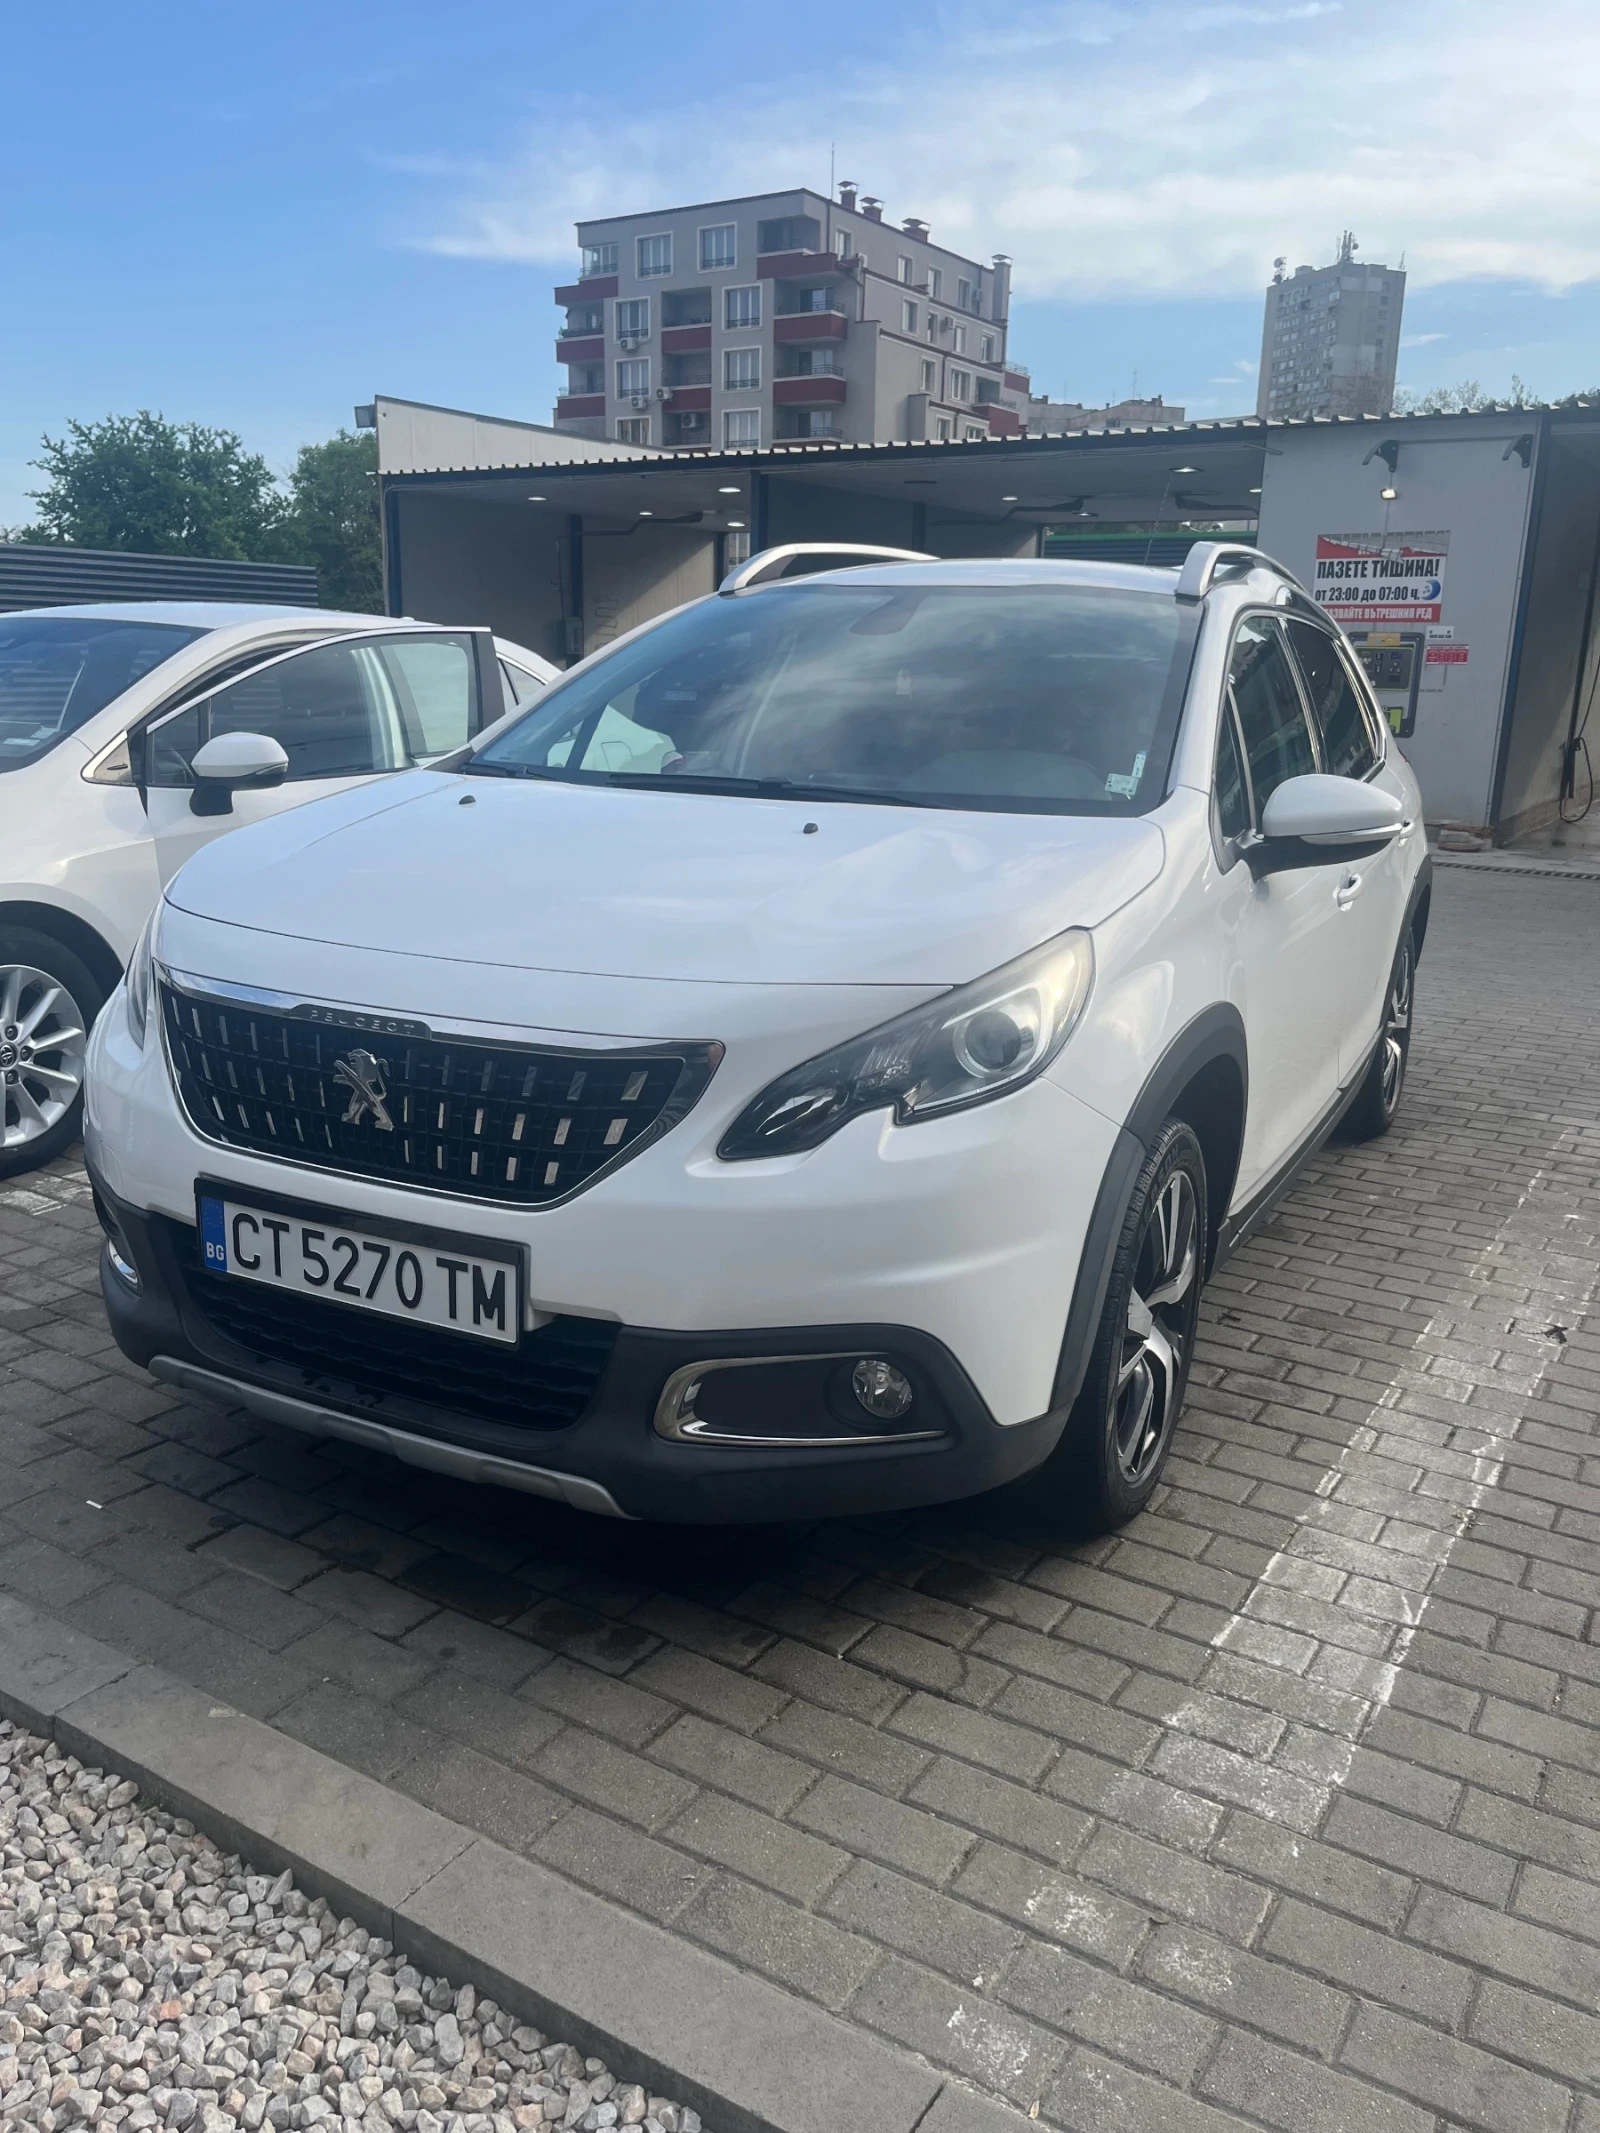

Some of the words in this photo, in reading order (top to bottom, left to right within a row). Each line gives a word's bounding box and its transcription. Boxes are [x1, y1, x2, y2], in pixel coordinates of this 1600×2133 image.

[1317, 561, 1368, 579] ПАЗЕТЕ
[1372, 559, 1440, 578] ТИШИНА!
[1315, 590, 1327, 601] от
[1329, 587, 1359, 602] 23:00
[1360, 589, 1376, 603] до
[1380, 586, 1408, 601] 07:00
[1411, 588, 1420, 600] ч.
[1325, 606, 1363, 619] АЗВАЙТЕ
[1416, 607, 1432, 620] РЕД
[310, 1010, 415, 1035] PEUGEOT
[206, 1241, 225, 1261] BG
[301, 1227, 423, 1309] 5270
